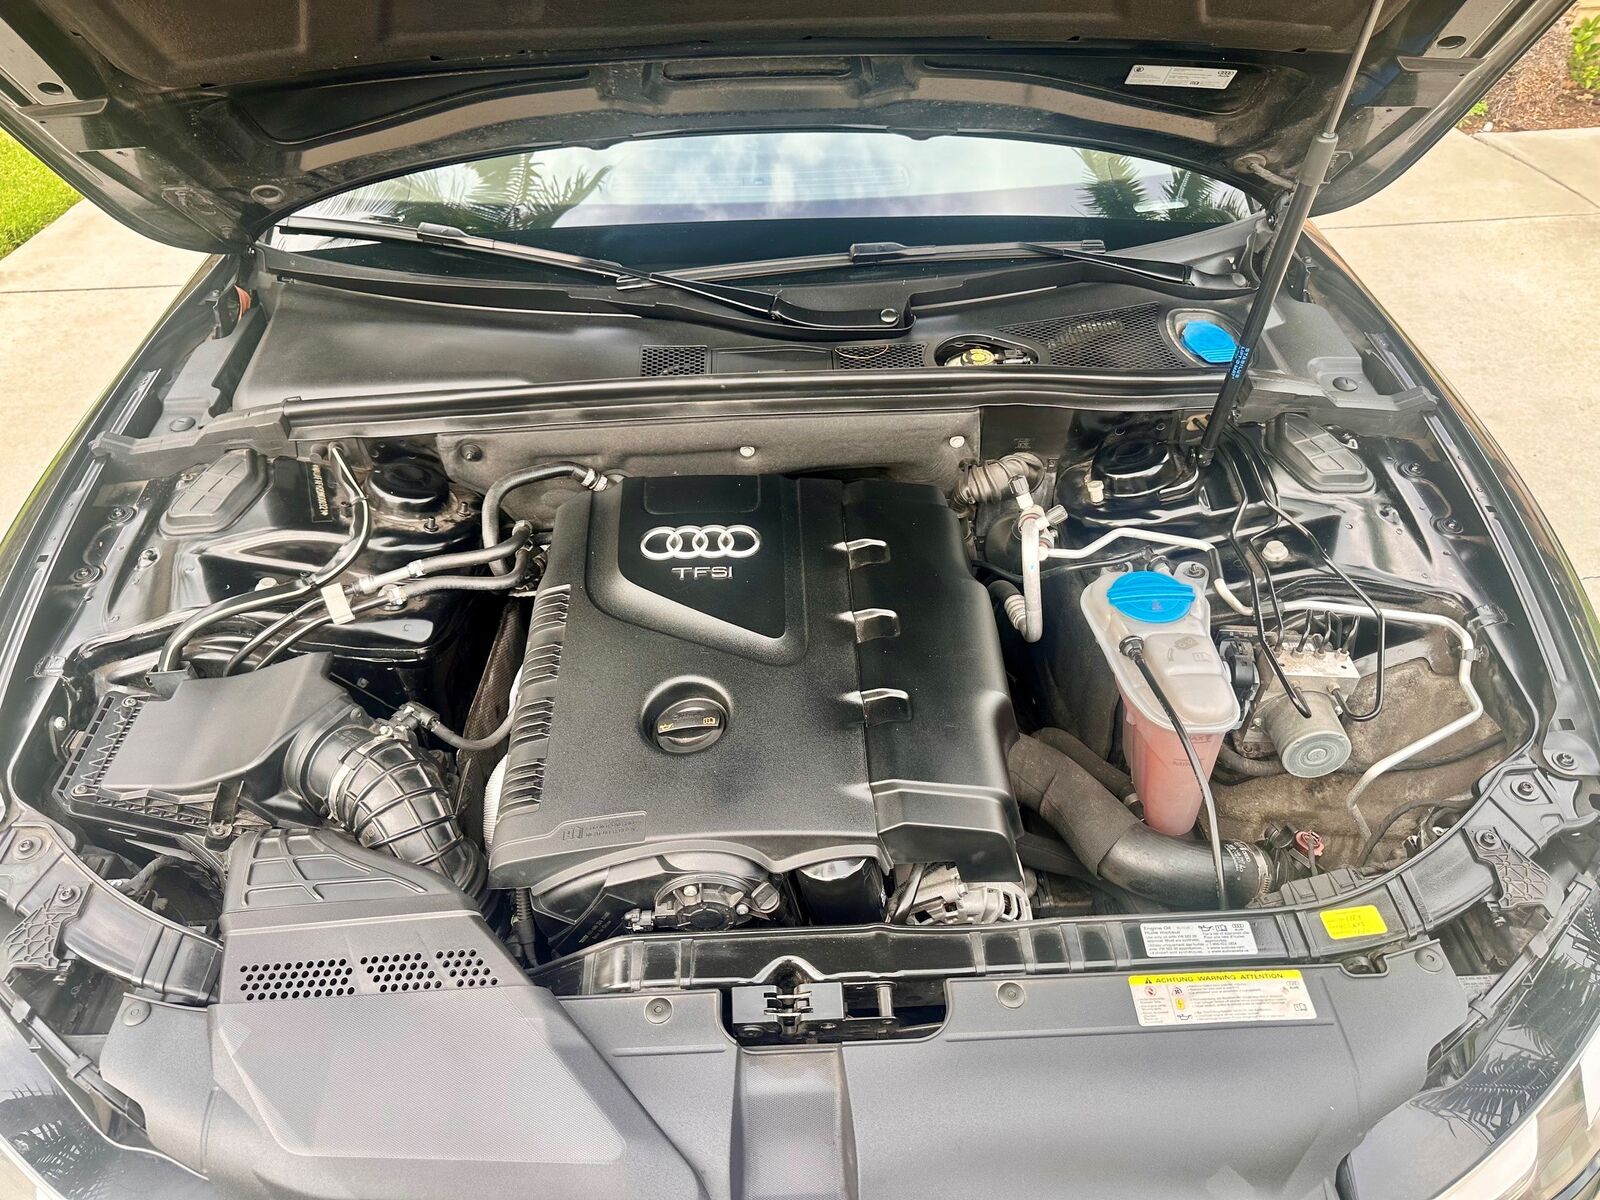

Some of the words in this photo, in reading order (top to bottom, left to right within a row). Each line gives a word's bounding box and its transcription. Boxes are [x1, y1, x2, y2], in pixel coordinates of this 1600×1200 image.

[671, 566, 734, 581] TFSI
[1155, 976, 1194, 984] ACHTUNG
[1197, 974, 1237, 982] WARNING
